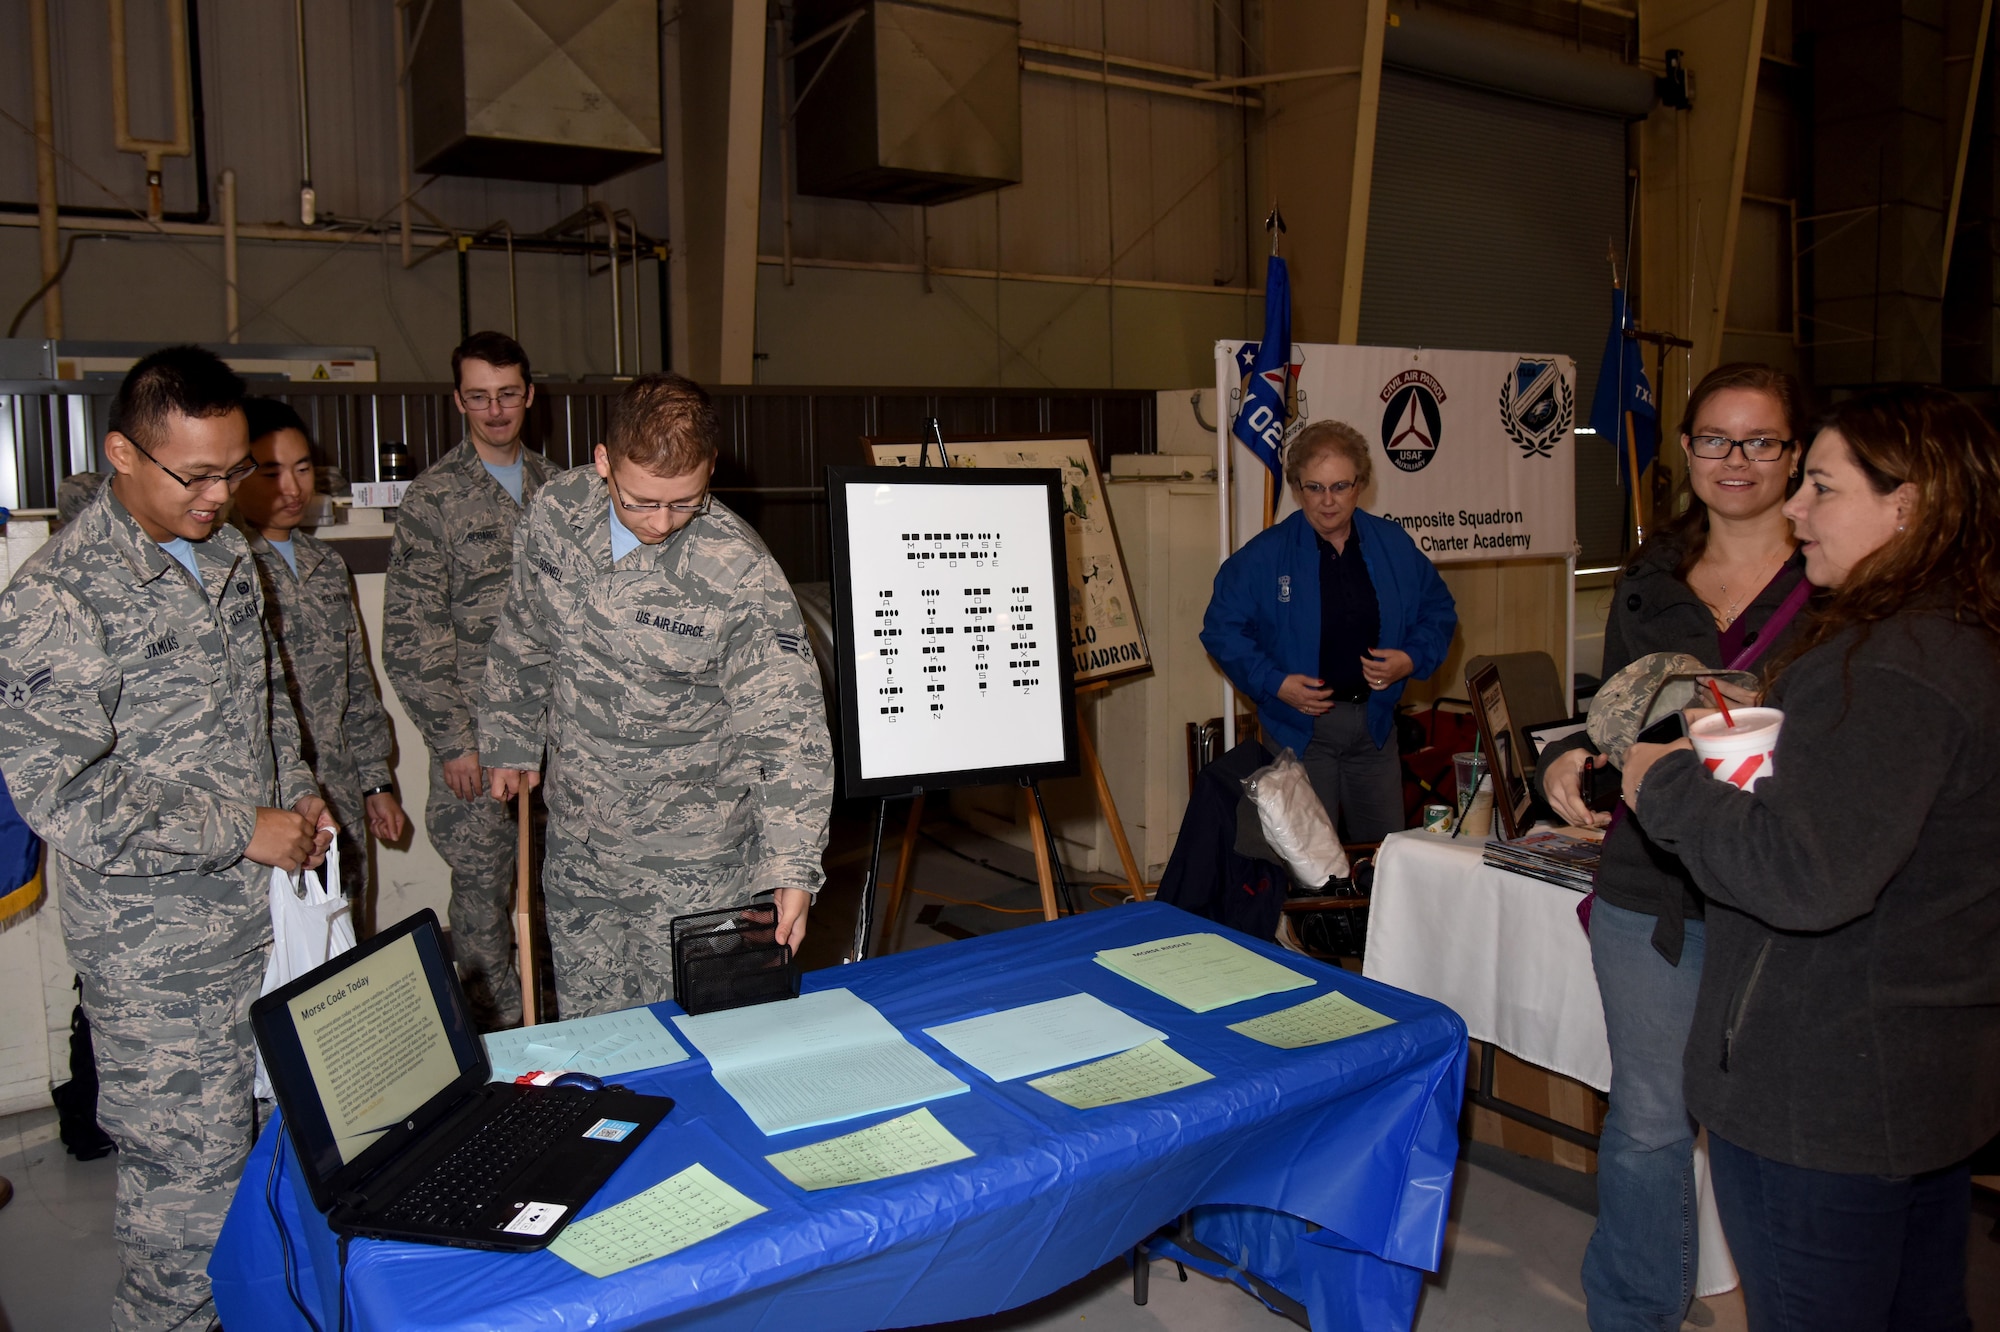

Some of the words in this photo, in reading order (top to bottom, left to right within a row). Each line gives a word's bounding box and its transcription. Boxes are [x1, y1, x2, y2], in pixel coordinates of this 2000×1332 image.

[1382, 376, 1403, 399] CIVIL
[1403, 371, 1418, 382] AIR
[1419, 371, 1444, 402] PATROL
[1394, 458, 1425, 470] AUXILIARY
[1400, 451, 1422, 460] USAF
[1459, 509, 1523, 529] Squadron
[1421, 536, 1468, 551] Charter
[1474, 533, 1531, 550] Academy
[653, 616, 670, 631] AIR
[672, 621, 705, 637] FORCE
[144, 636, 180, 659] JAMIAS
[301, 1003, 326, 1021] Morse
[327, 989, 347, 1006] Code
[346, 975, 370, 994] Today
[712, 1220, 730, 1229] CODE
[628, 1252, 654, 1264] MORSE
